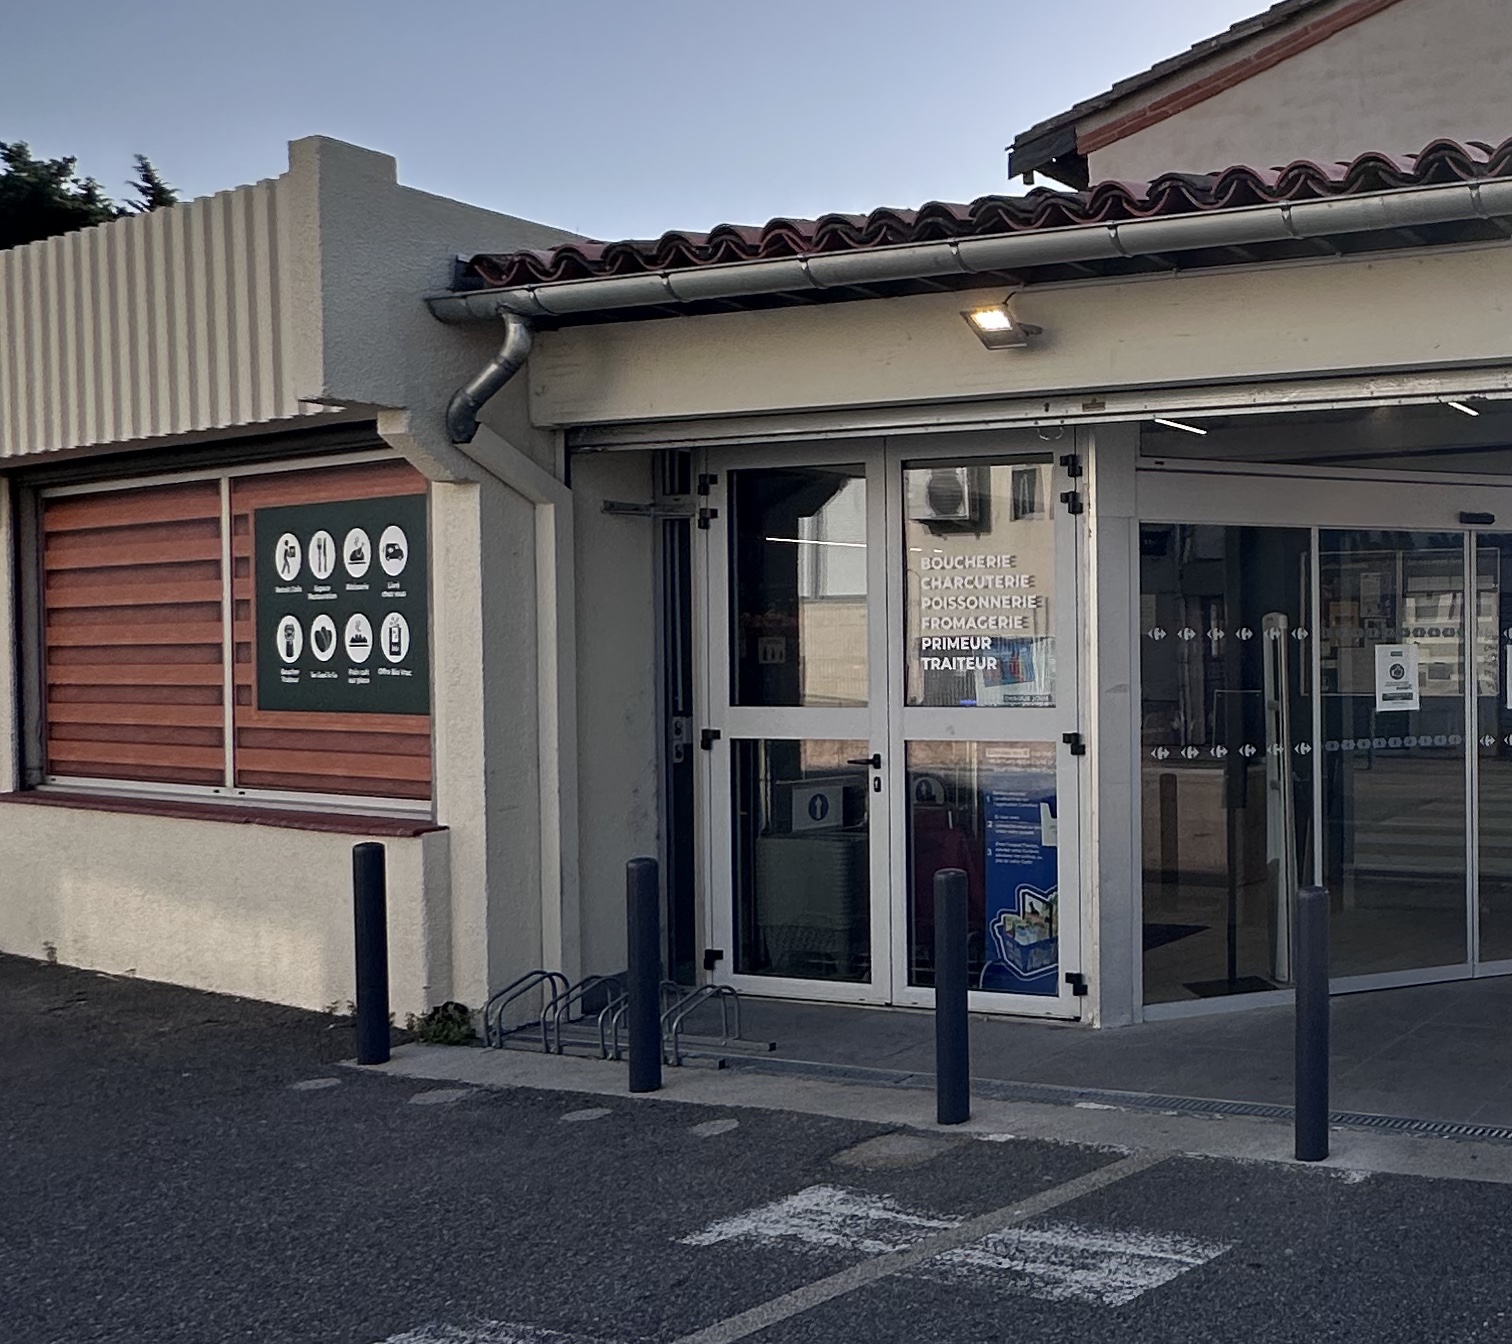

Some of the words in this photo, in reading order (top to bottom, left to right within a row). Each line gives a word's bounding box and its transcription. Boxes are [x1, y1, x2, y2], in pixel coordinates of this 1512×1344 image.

[921, 555, 1012, 570] BOUCHERIE
[921, 575, 1030, 590] CHARCUTERIE
[921, 596, 1037, 610] POISSONNERIE
[921, 616, 1024, 630] FROMAGERIE
[921, 636, 992, 650] PRIMEUR
[921, 656, 997, 670] TRAITEUR
